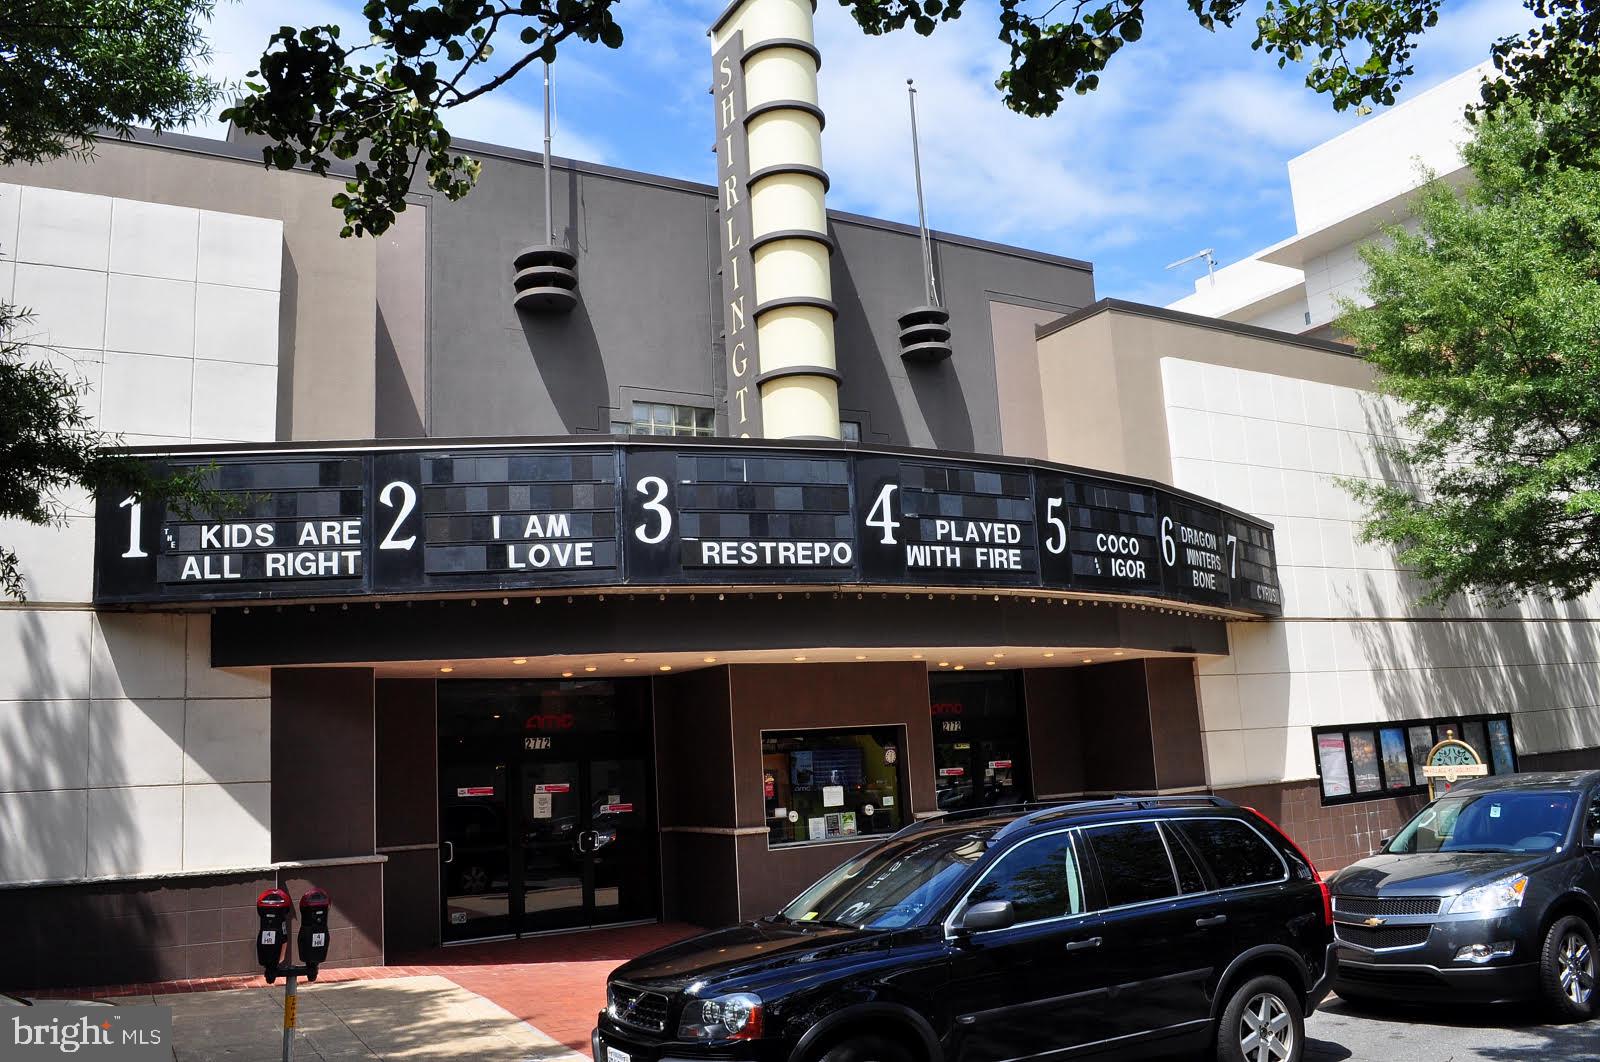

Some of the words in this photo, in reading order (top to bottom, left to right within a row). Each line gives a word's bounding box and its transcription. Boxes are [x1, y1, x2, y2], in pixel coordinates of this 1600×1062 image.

[720, 56, 750, 438] SHIRLINGT
[380, 481, 416, 550] 2
[635, 477, 671, 543] 3
[866, 485, 900, 544] 4
[120, 491, 147, 557] 1
[164, 528, 176, 549] THE
[201, 524, 274, 549] KIDS
[299, 522, 361, 545] ARE
[493, 516, 499, 538] I
[524, 514, 570, 537] AM
[936, 520, 1021, 544] PLAYED
[1046, 498, 1066, 553] 5
[1097, 534, 1139, 555] COCO
[1162, 517, 1175, 566] 6
[1181, 526, 1216, 551] DRAGON
[181, 556, 240, 579] ALL
[267, 551, 361, 576] RIGHT
[509, 543, 593, 568] LOVE
[702, 542, 852, 565] RESTREPO
[907, 545, 960, 566] WITH
[976, 548, 1021, 569] FIRE
[1187, 548, 1221, 571] WINTERS
[1227, 535, 1236, 578] 7
[1112, 558, 1145, 578] IGOR
[1193, 569, 1216, 590] BONE
[525, 738, 550, 749] 2772
